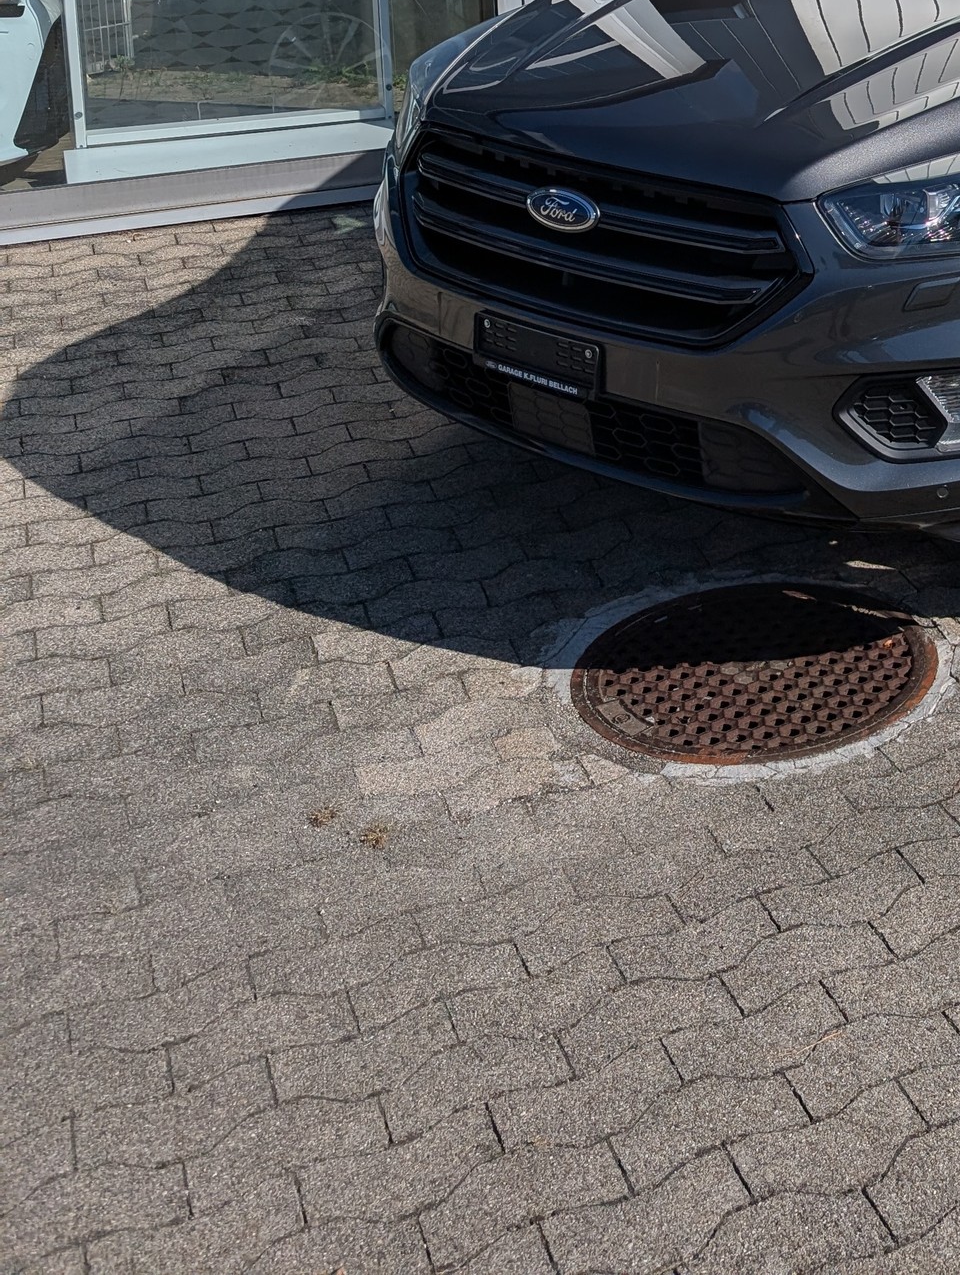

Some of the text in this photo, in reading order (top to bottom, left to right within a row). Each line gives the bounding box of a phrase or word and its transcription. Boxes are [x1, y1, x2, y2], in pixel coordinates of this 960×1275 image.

[540, 196, 578, 222] Ford
[498, 364, 523, 378] GARAGE
[549, 380, 578, 395] BELLACH
